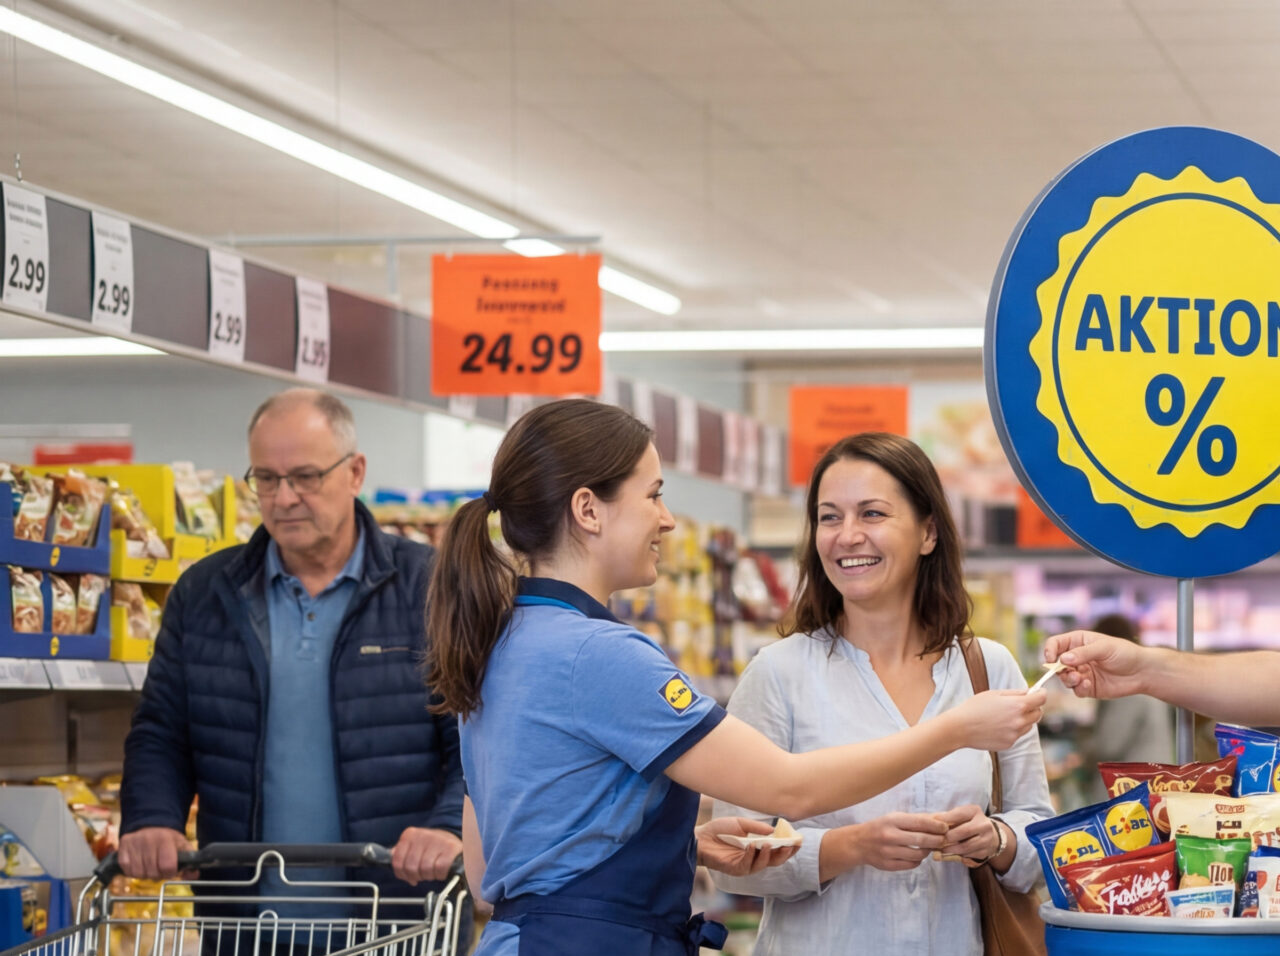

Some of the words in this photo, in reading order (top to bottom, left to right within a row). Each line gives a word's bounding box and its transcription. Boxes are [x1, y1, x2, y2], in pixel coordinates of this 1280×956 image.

[8, 253, 46, 294] 2.99
[98, 279, 131, 316] 2.99
[459, 332, 584, 375] 24.99
[1144, 373, 1238, 477] %
